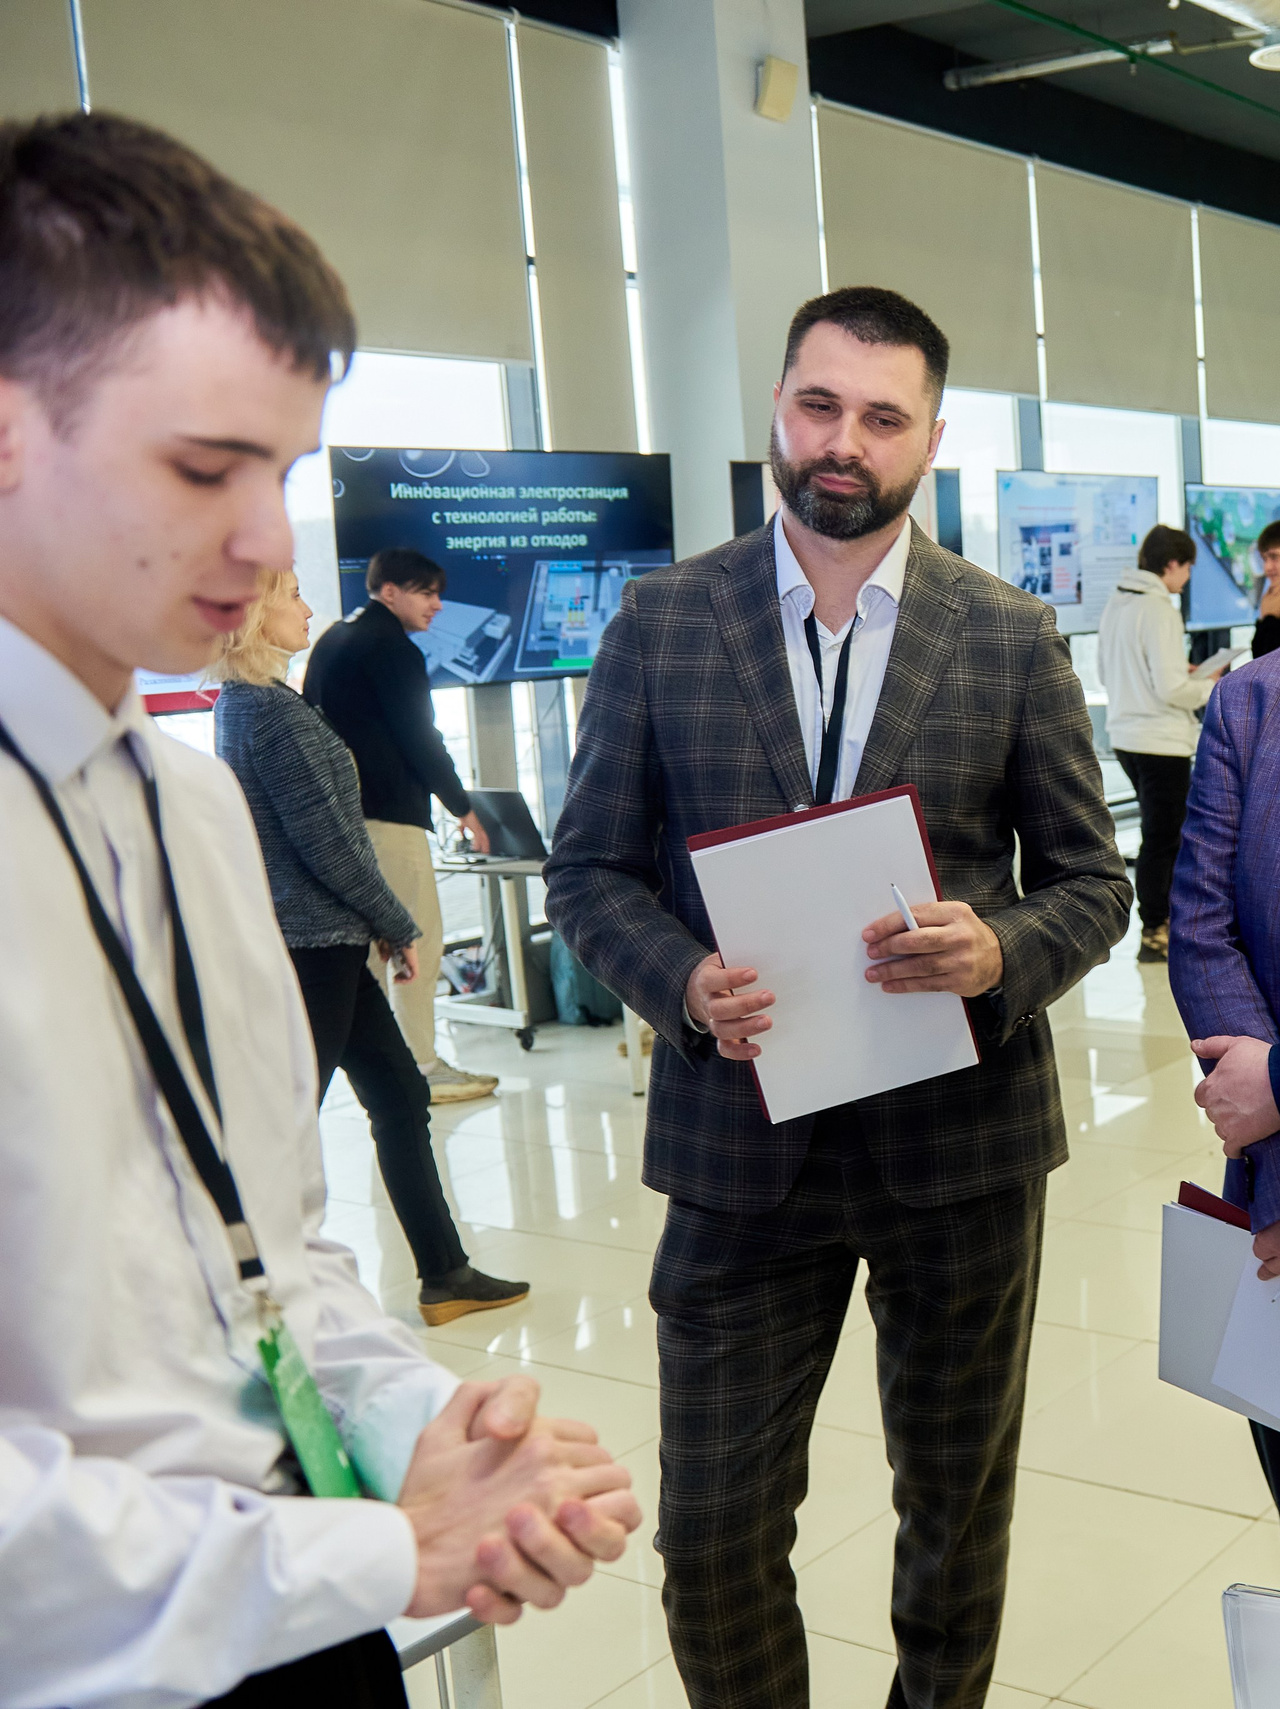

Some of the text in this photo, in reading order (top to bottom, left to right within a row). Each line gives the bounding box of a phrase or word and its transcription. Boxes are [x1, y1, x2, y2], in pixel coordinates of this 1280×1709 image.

[390, 482, 628, 501] Инновационная электростанция
[432, 507, 598, 526] с технологией работы:
[446, 533, 588, 552] энергия из отходов
